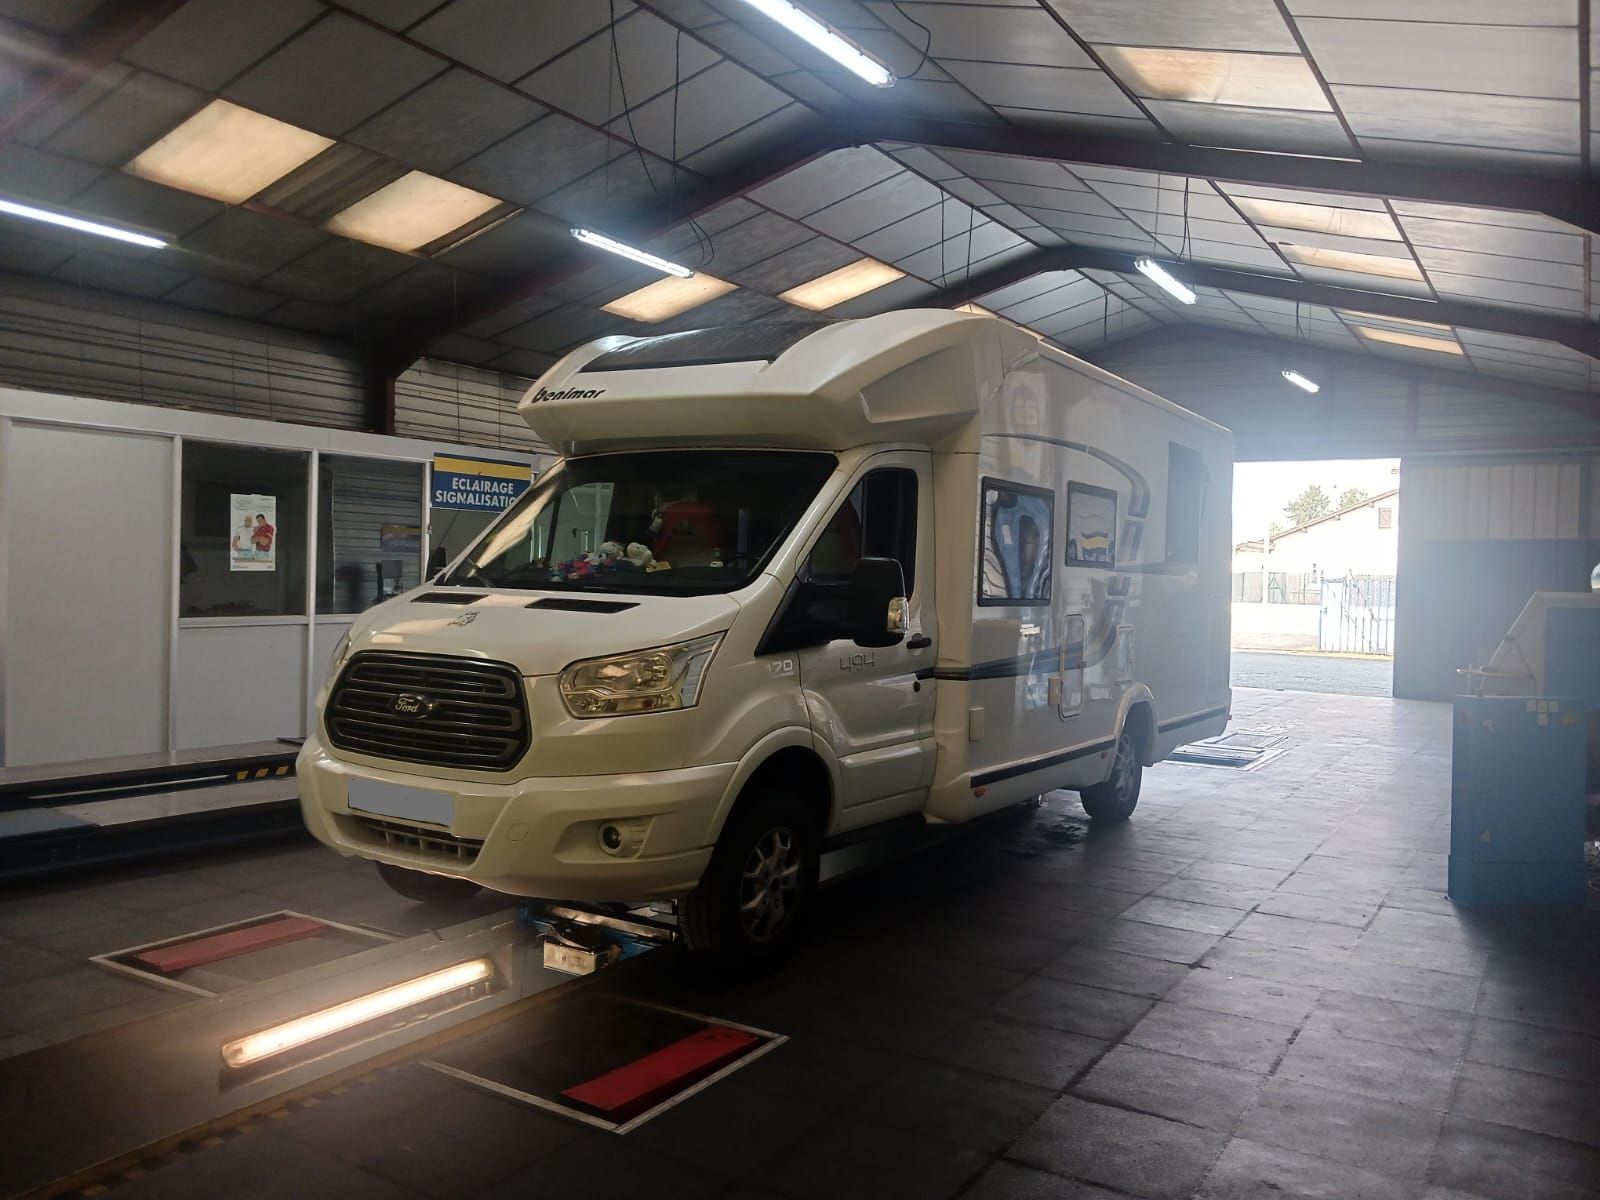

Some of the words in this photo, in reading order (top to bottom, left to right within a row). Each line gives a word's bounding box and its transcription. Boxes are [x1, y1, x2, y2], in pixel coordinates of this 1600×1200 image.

[452, 477, 514, 495] ECLAIRAGE
[435, 490, 517, 508] SIGNALISATI
[839, 651, 874, 673] 494
[395, 697, 420, 713] Ford
